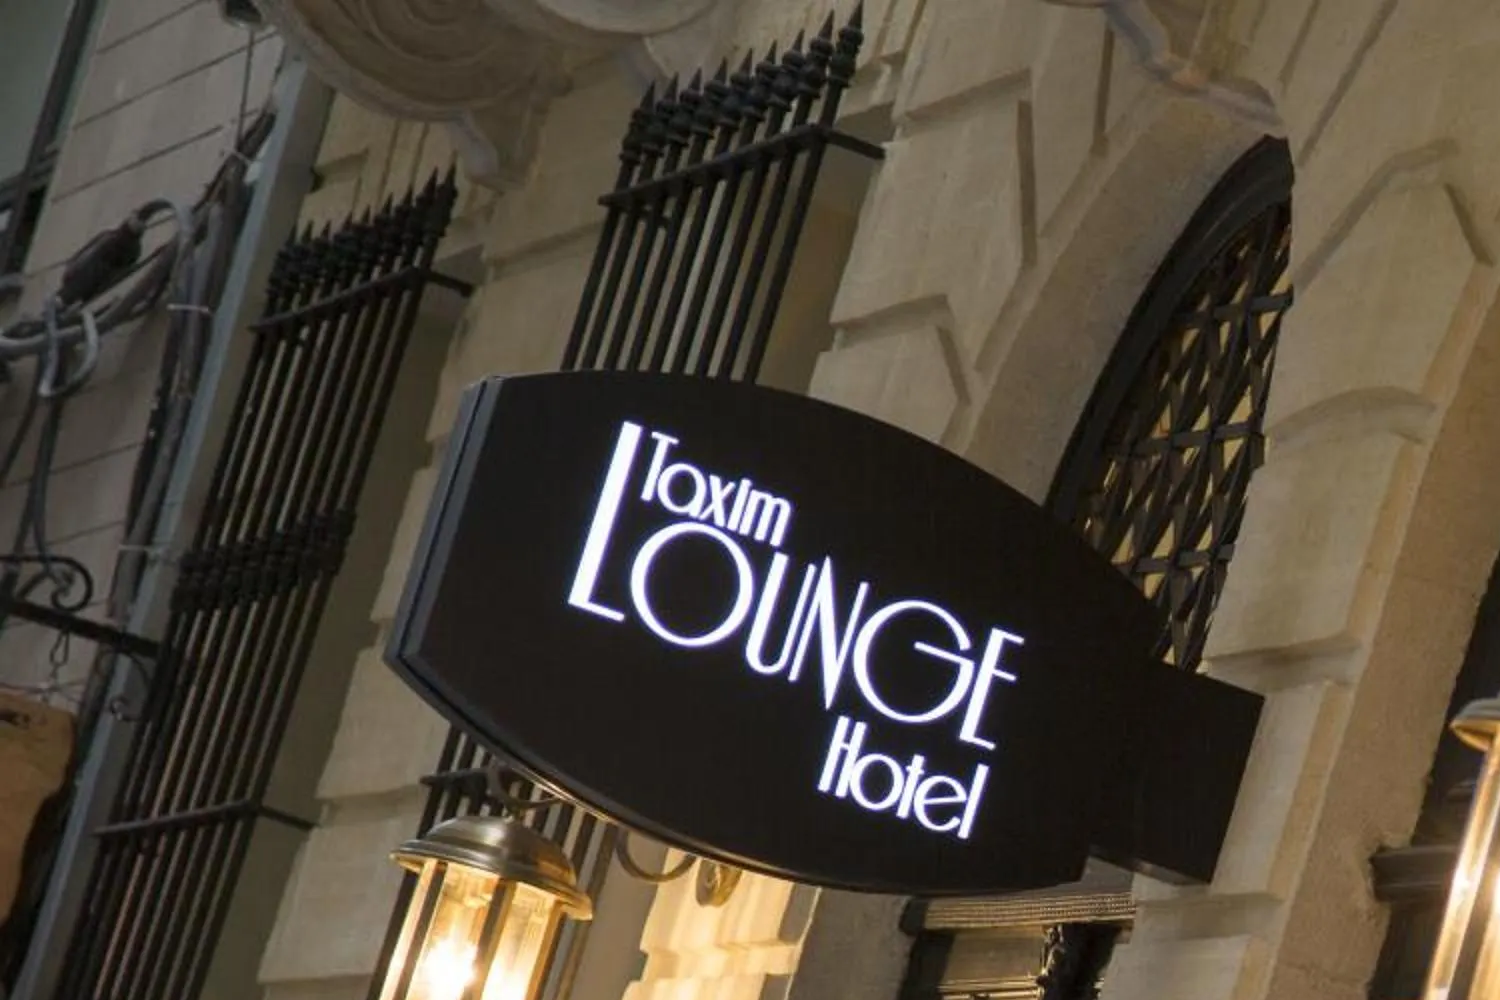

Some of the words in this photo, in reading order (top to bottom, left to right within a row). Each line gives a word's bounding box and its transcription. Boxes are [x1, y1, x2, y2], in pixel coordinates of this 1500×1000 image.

[640, 431, 792, 547] Taxim
[567, 421, 1025, 750] LOUNGE
[817, 715, 990, 840] Hotel
